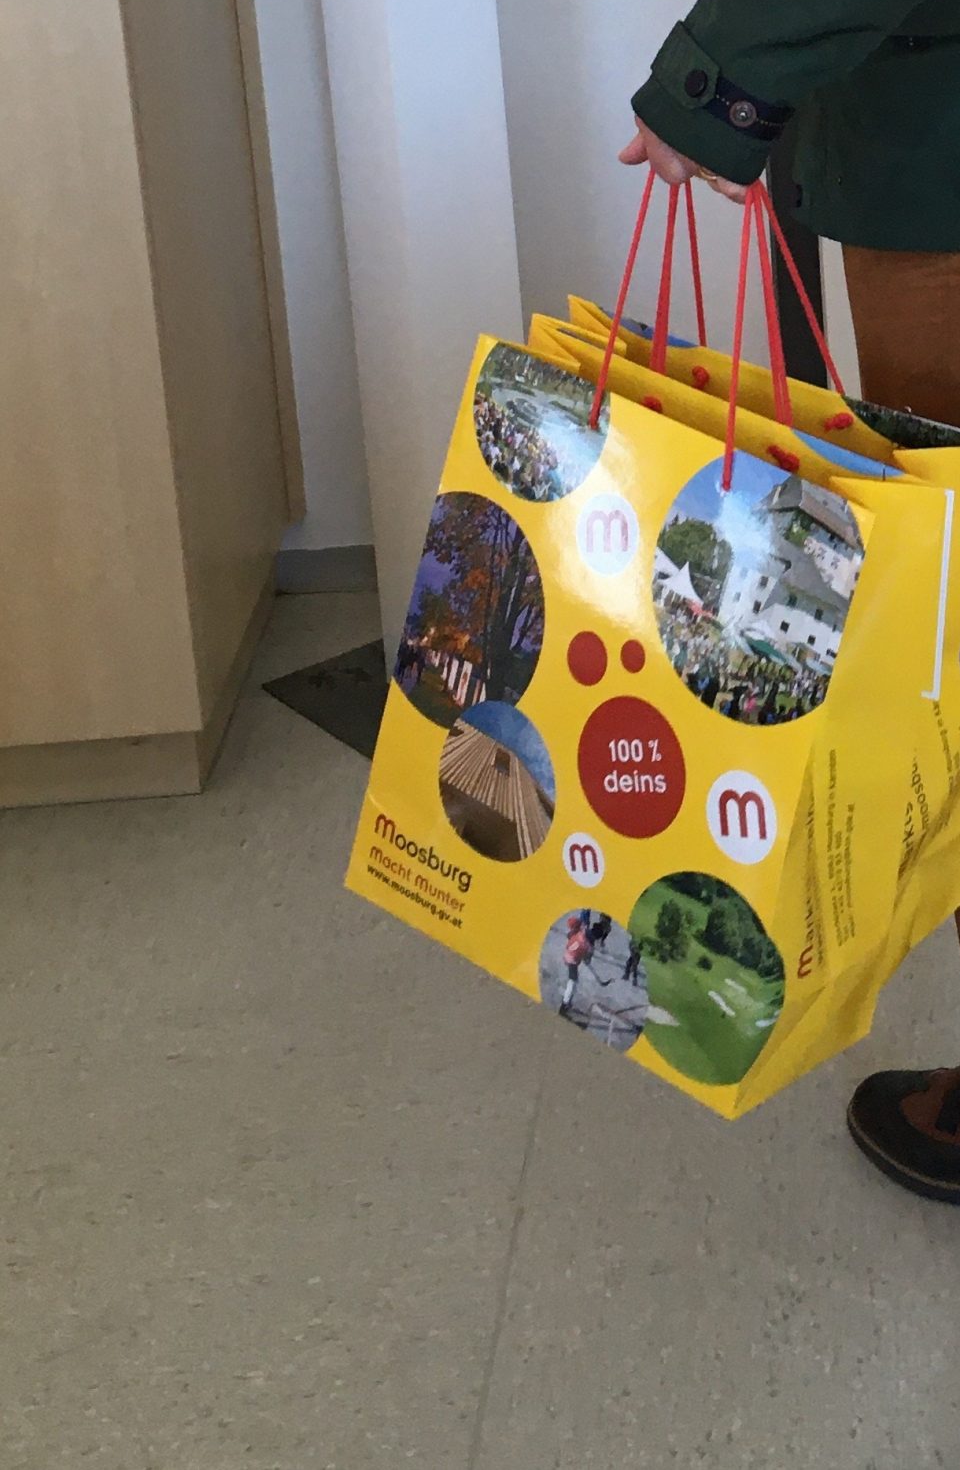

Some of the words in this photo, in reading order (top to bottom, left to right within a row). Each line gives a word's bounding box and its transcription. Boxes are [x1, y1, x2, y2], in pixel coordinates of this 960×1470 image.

[586, 509, 630, 553] m
[608, 738, 644, 763] 100
[648, 738, 662, 763] %
[603, 770, 667, 794] deins
[718, 789, 767, 841] m
[374, 813, 472, 893] moosburg
[568, 843, 599, 874] m
[367, 864, 463, 930] www.moosburg.gv.at
[369, 846, 412, 881] macht
[414, 874, 465, 912] munter
